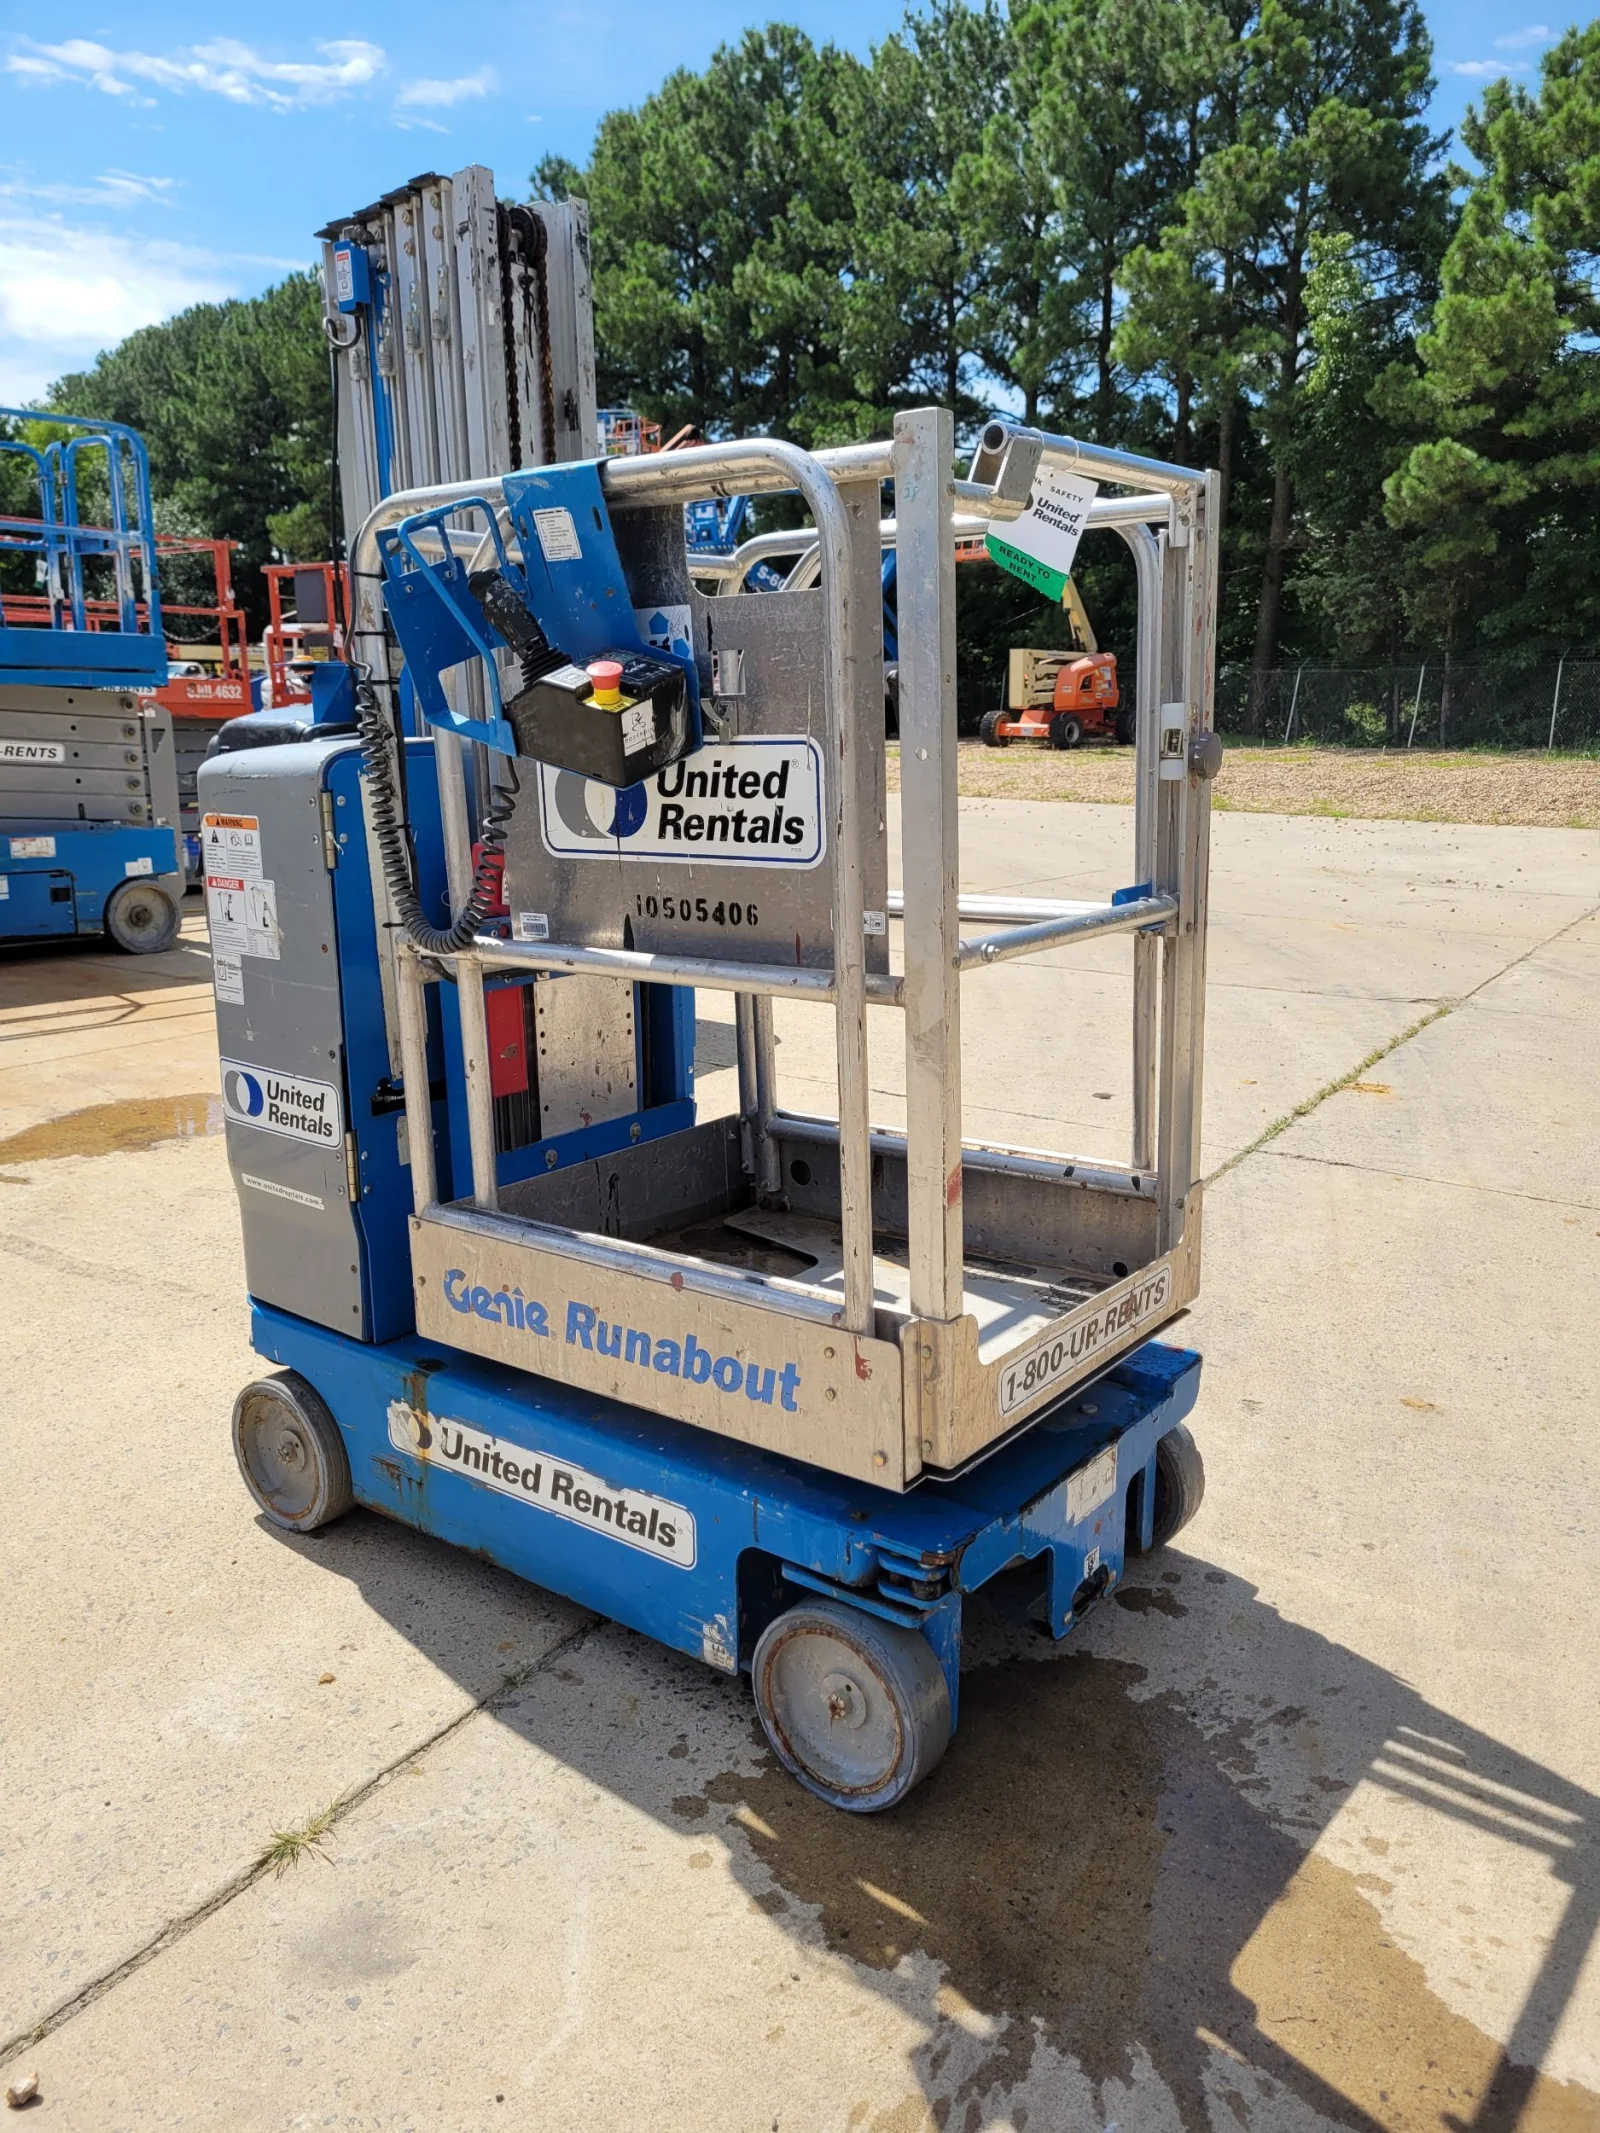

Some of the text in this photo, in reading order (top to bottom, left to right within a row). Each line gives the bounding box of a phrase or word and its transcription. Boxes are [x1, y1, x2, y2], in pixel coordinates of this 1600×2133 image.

[1037, 497, 1082, 524] United
[1050, 485, 1084, 503] SAFETY
[1033, 508, 1079, 536] Rentals
[999, 546, 1050, 579] READY TO
[1009, 562, 1037, 582] RENT
[657, 759, 791, 799] United
[658, 803, 805, 845] Rentals
[216, 879, 240, 889] DANGER
[636, 894, 759, 926] 10505406
[266, 1079, 325, 1112] United
[268, 1103, 333, 1138] Rentals
[246, 1177, 320, 1206] www.unitedrentals.com
[443, 1268, 801, 1413] Genie Runabout
[1006, 1276, 1165, 1402] 1-800-UR-RENTS
[439, 1427, 677, 1548] United Rentals
